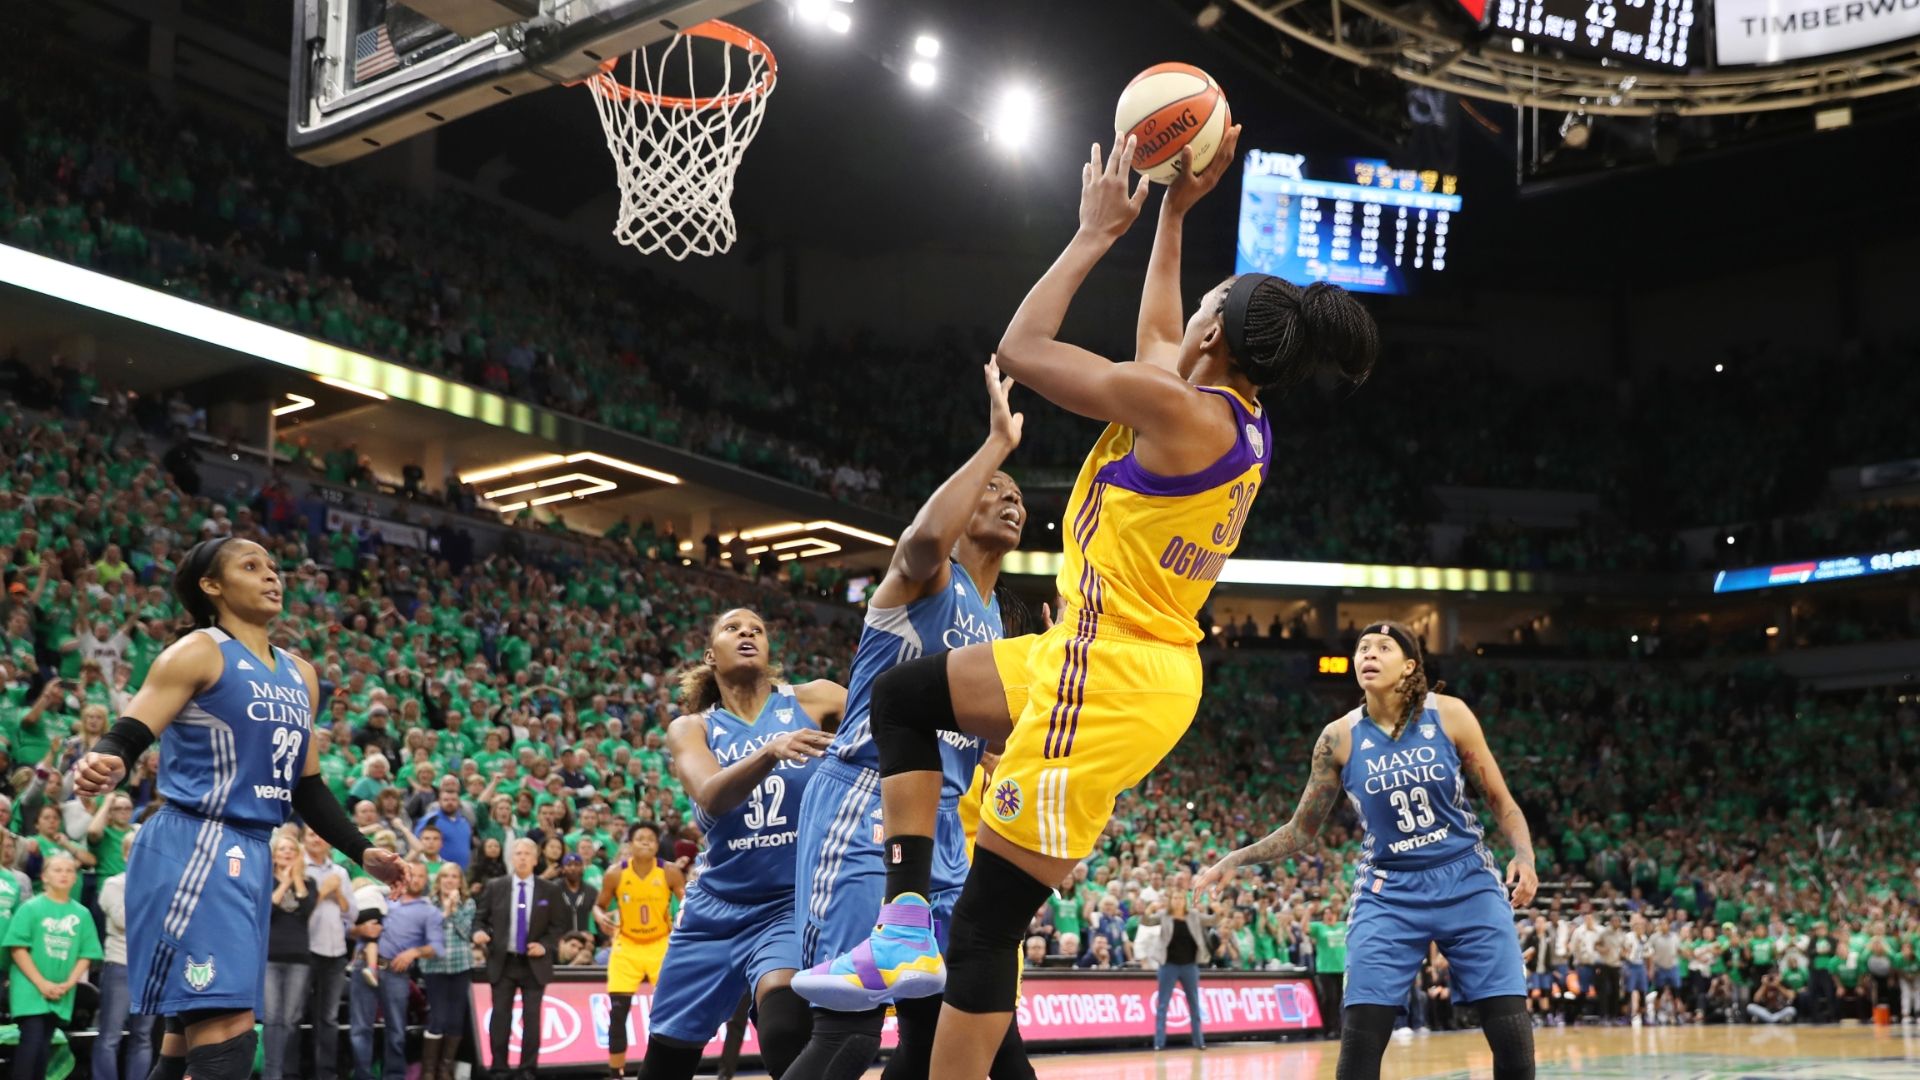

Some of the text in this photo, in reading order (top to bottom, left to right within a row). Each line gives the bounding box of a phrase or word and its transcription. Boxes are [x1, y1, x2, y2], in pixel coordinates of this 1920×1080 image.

[1133, 108, 1198, 166] PALDING
[953, 604, 1002, 643] MAY
[248, 680, 310, 708] MAYO
[272, 727, 303, 781] 23
[1365, 746, 1436, 775] MAYO
[1364, 764, 1446, 794] CLINIC
[744, 775, 787, 829] 32
[1389, 787, 1435, 832] 33
[728, 831, 794, 851] verizon
[1388, 828, 1448, 854] verizon
[1033, 994, 1121, 1026] OCTOBER
[1120, 993, 1146, 1023] 25
[1204, 987, 1276, 1023] TIP-OFF
